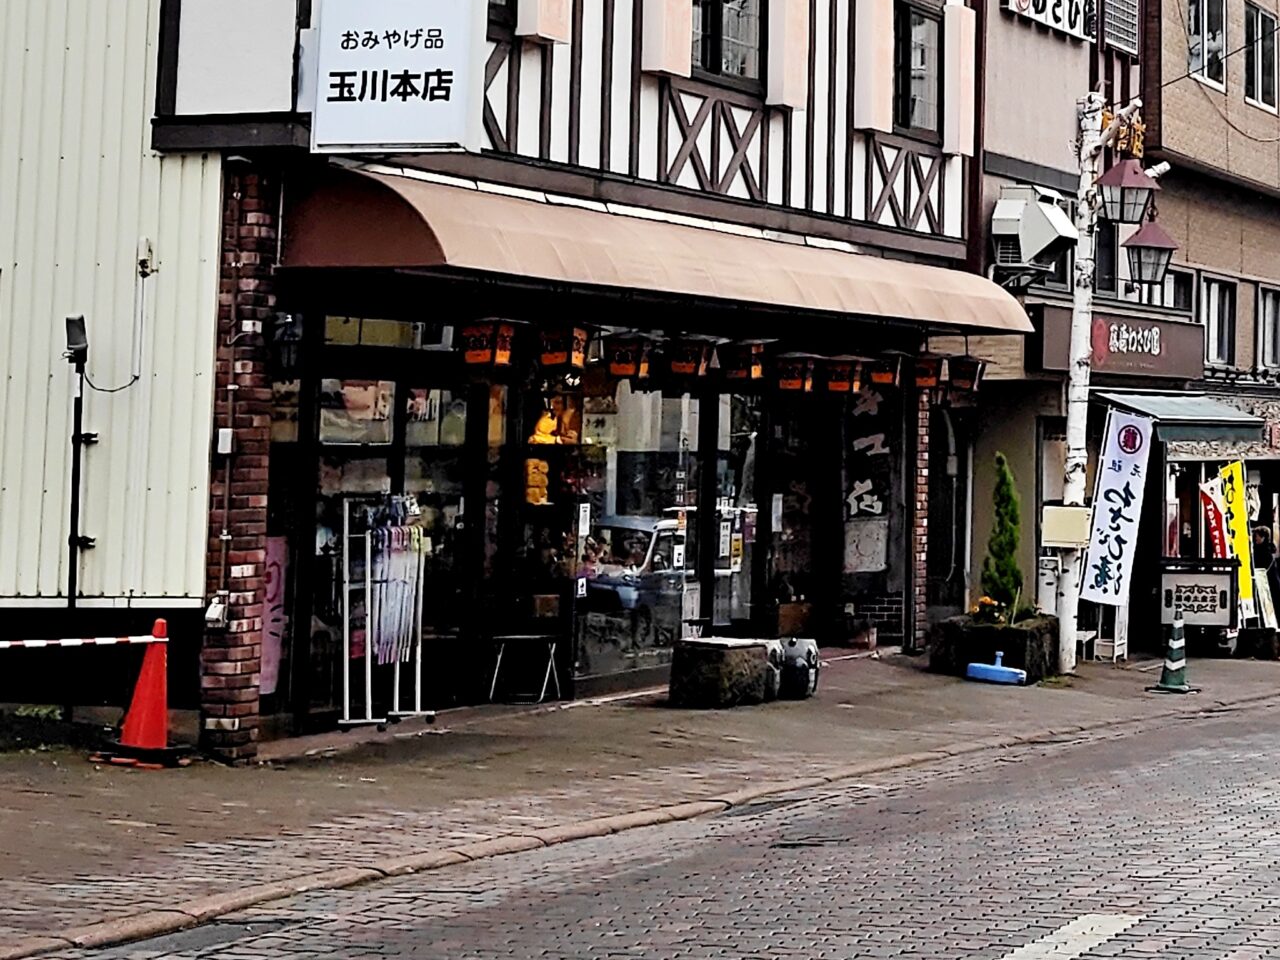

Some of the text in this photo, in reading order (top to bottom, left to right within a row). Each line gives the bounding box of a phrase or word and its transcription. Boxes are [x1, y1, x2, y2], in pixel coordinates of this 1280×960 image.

[340, 28, 444, 50] おみやげ品
[326, 68, 453, 102] 玉川本店
